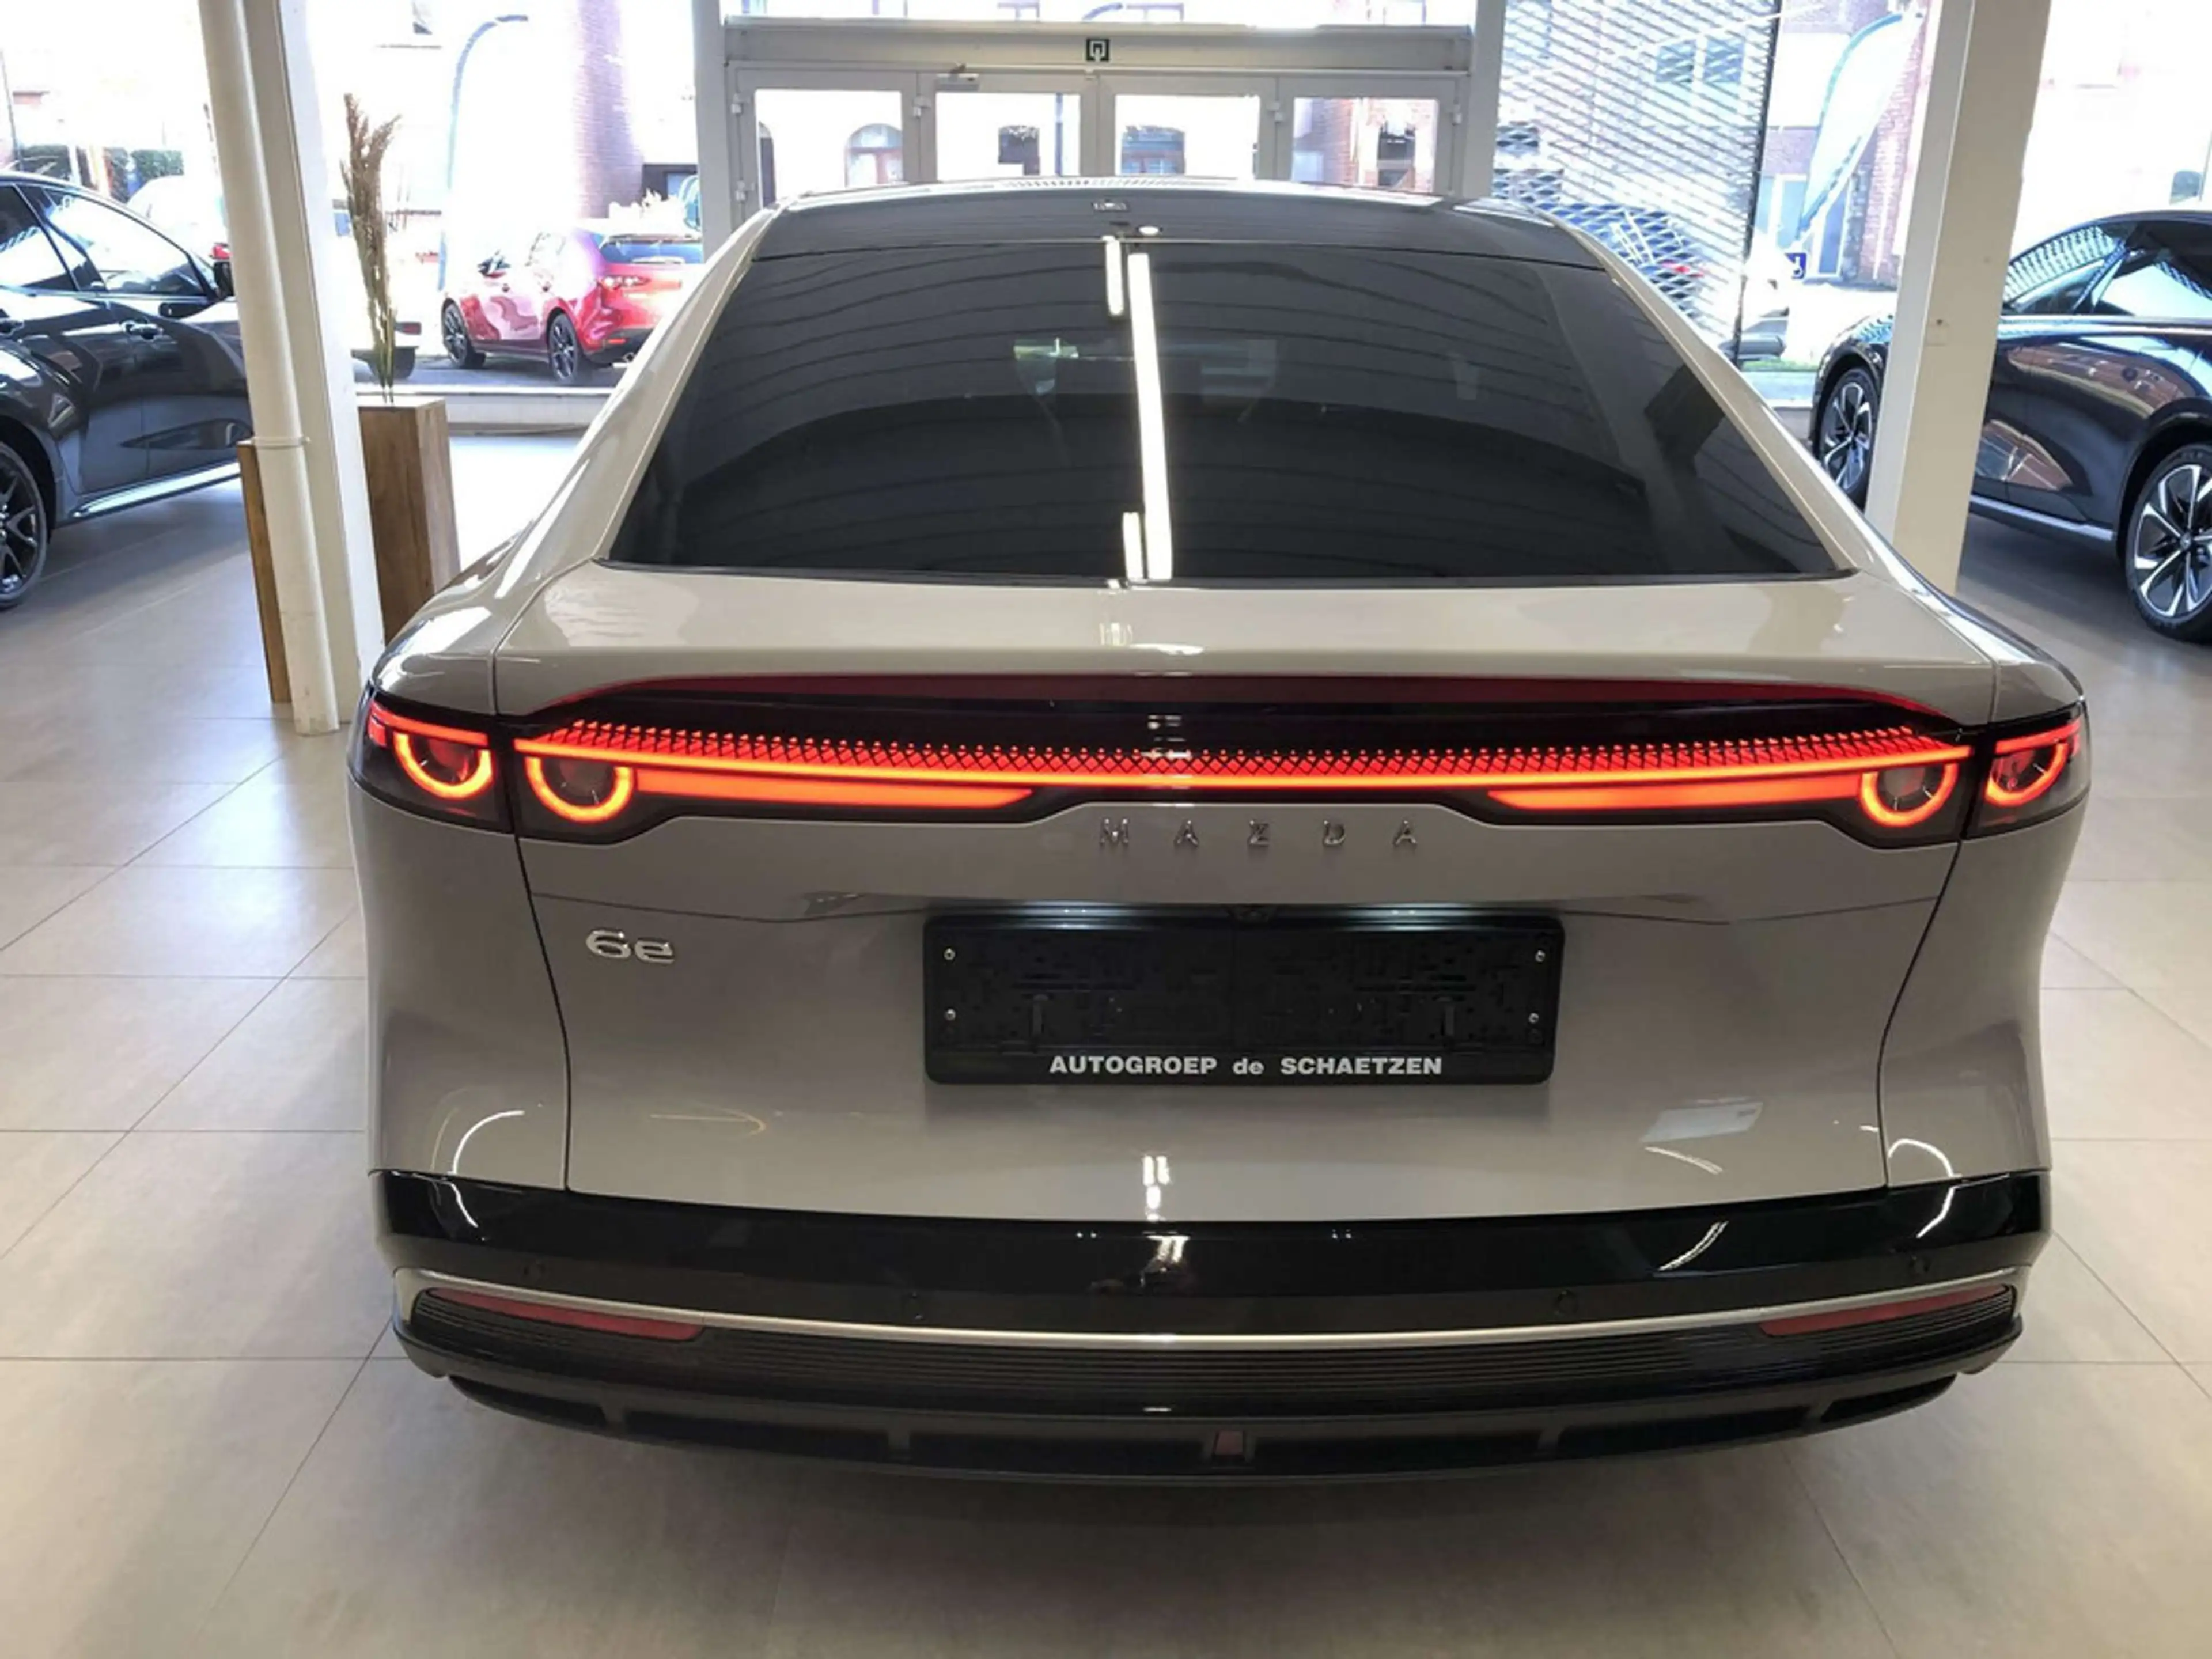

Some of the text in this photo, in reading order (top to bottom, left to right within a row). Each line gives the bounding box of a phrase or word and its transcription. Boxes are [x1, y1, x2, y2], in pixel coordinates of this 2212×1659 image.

[1100, 817, 1418, 846] MAZDA
[585, 930, 676, 964] 6e
[1049, 1055, 1442, 1075] AUTOGROEP de SCHAETZEN
